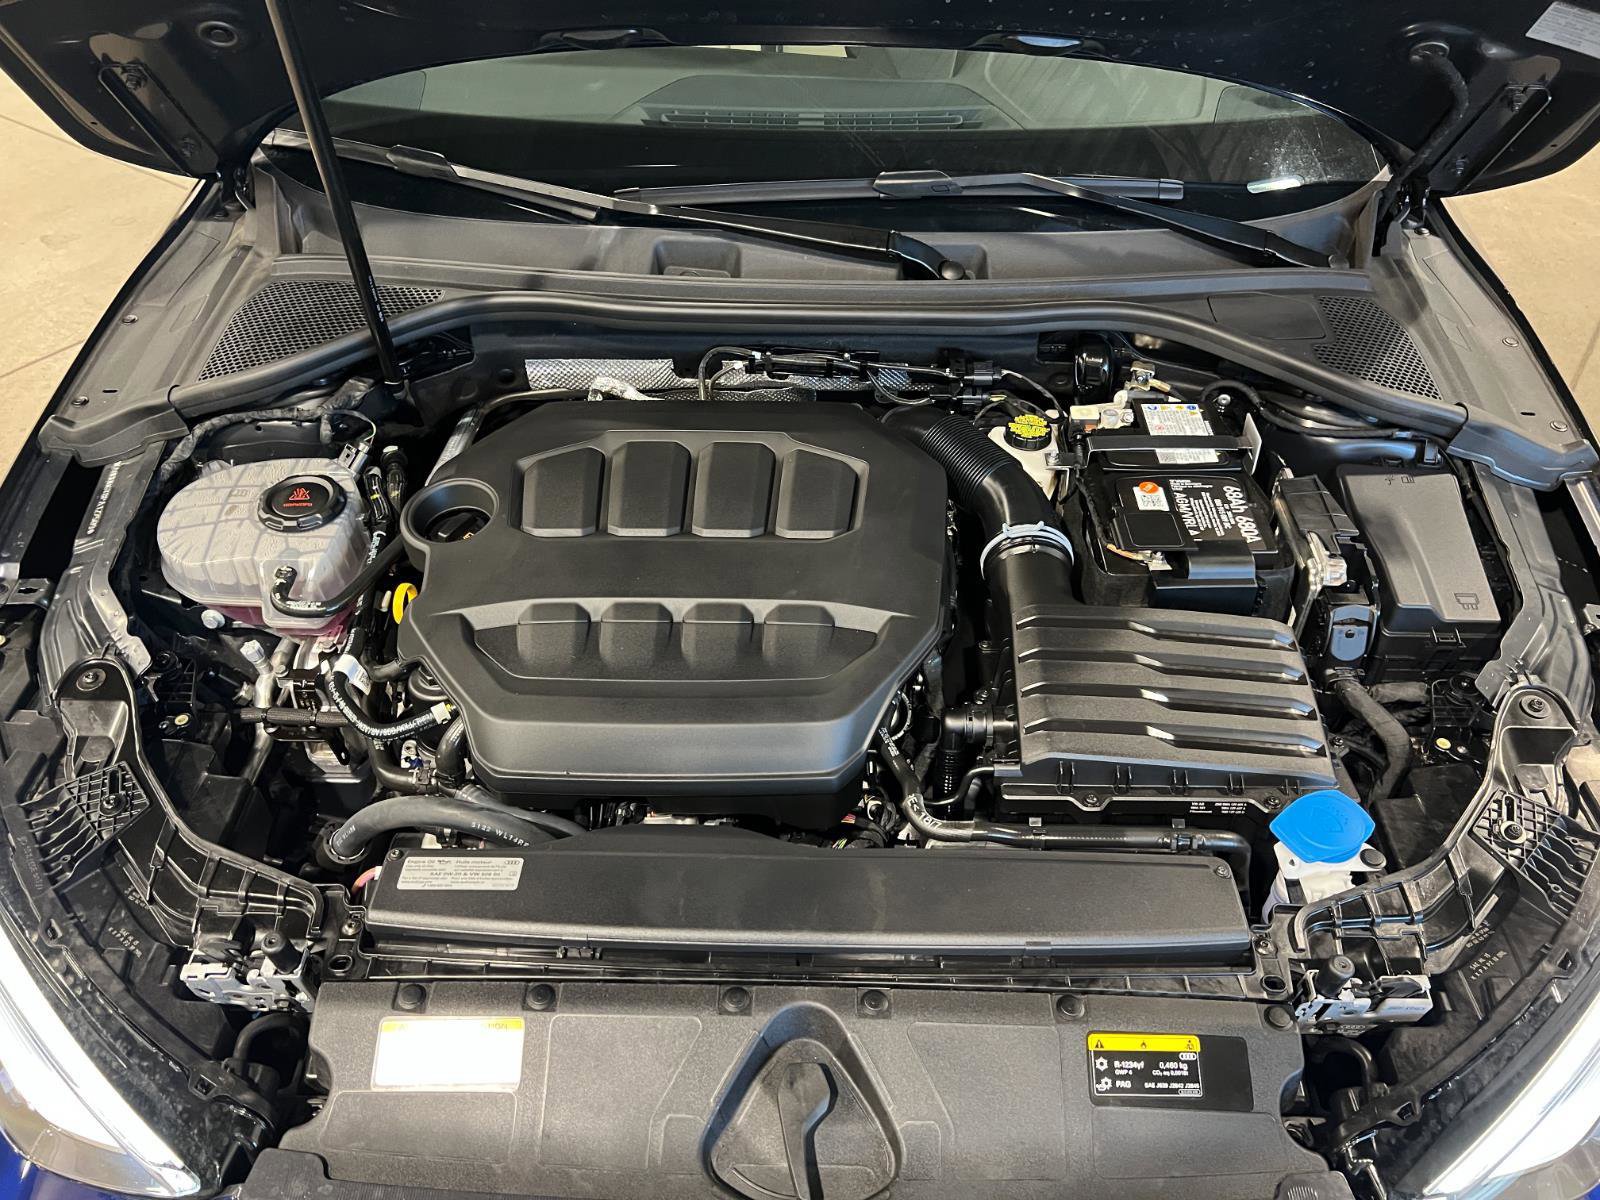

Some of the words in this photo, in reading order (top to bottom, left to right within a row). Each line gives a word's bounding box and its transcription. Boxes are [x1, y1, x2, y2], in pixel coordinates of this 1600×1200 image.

[1223, 486, 1248, 514] 68Ah
[1236, 516, 1262, 544] 680A
[1114, 1060, 1144, 1071] R-1234yf
[1179, 1061, 1188, 1071] kg
[1115, 1080, 1132, 1088] PAG
